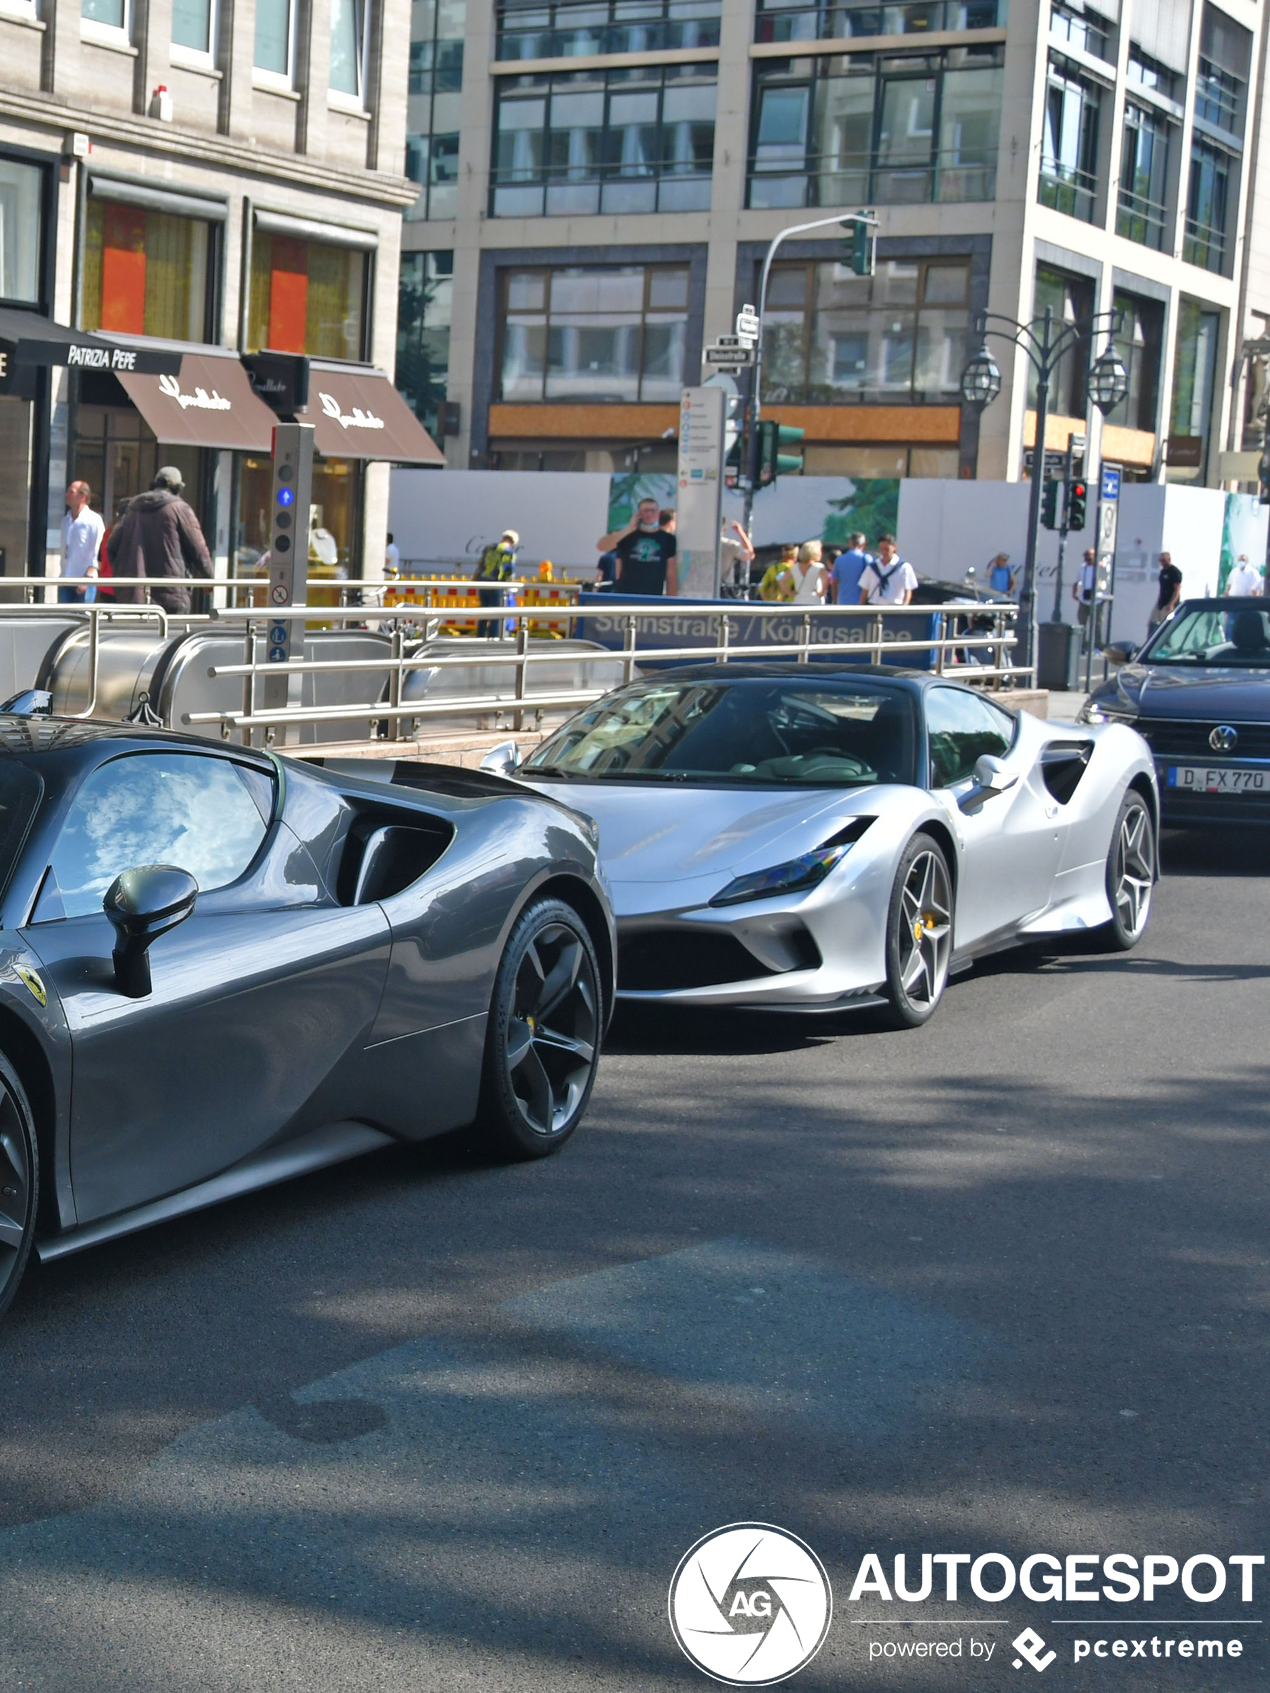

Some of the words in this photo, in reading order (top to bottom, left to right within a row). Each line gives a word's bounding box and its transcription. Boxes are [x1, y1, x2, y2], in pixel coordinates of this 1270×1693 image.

[67, 345, 110, 368] PATRIZIA
[112, 349, 137, 370] PEPE
[744, 616, 756, 641] /
[761, 615, 912, 643] Köigsalee
[1184, 770, 1195, 785] D
[1206, 771, 1228, 787] FX
[1233, 772, 1264, 788] 770
